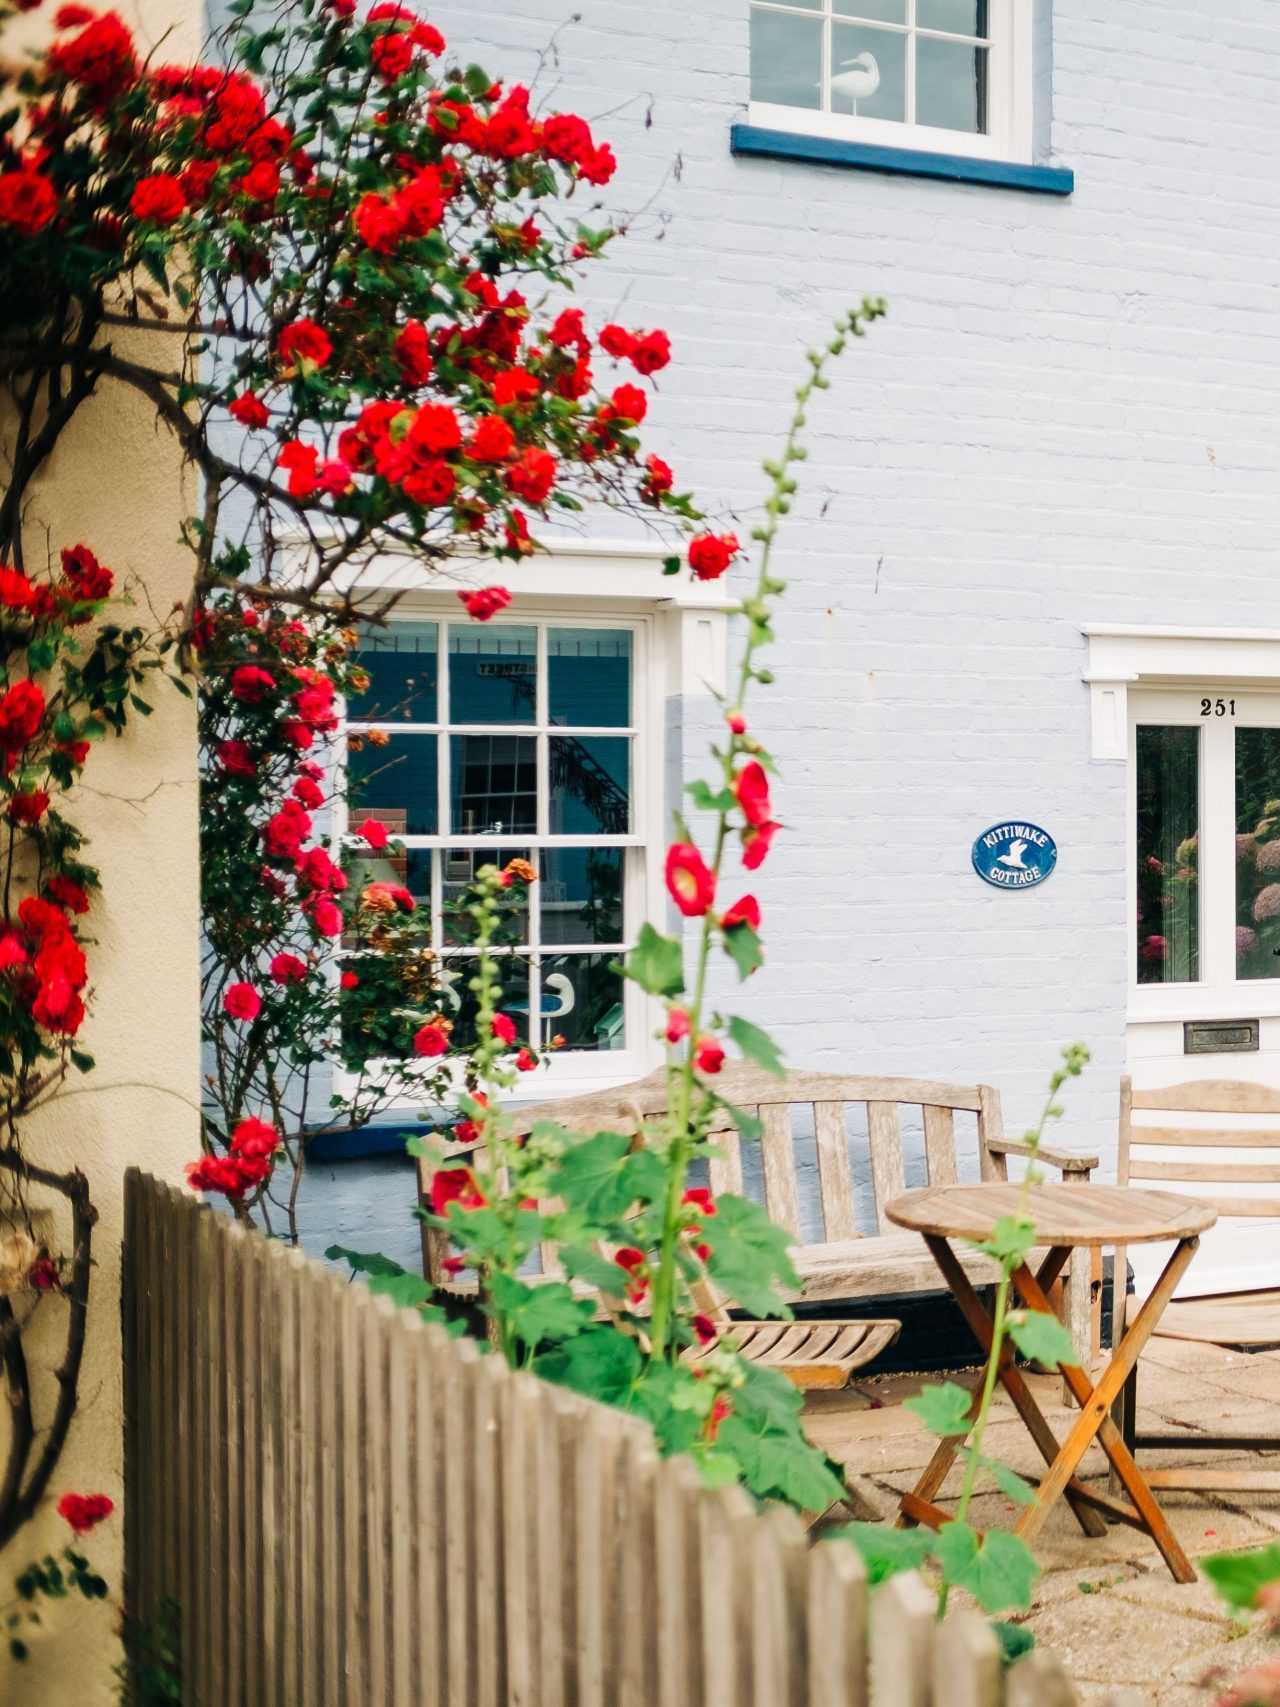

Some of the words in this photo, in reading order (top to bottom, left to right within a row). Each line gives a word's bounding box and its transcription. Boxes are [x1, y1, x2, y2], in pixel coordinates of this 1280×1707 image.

[1200, 698, 1236, 717] 251
[982, 825, 1049, 849] KITTIWAKE
[990, 866, 1042, 884] COTTAGE
